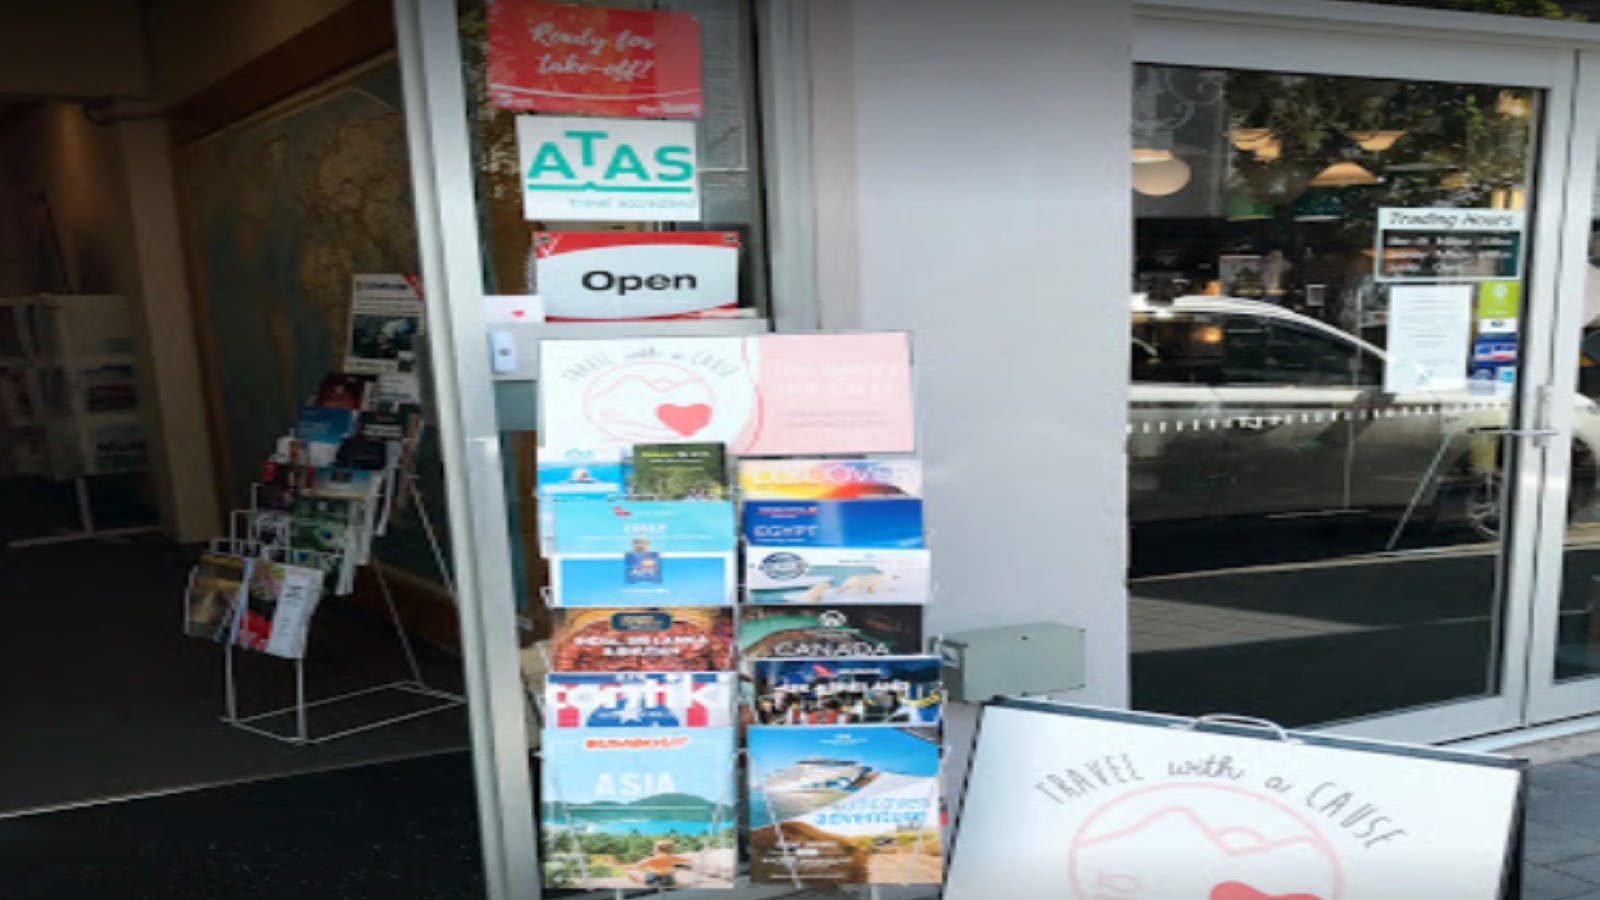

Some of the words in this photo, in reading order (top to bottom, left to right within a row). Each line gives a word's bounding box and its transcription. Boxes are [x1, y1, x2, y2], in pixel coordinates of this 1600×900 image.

[531, 21, 606, 55] Ready
[613, 28, 654, 51] for
[527, 131, 694, 182] ATAS
[1389, 211, 1459, 229] Trading
[581, 270, 697, 296] Open
[753, 524, 818, 537] EGYPT
[774, 640, 890, 656] CANADA
[595, 772, 677, 797] ASIA
[1034, 753, 1145, 805] TRAVEL
[1167, 755, 1247, 781] with
[1264, 774, 1293, 794] a
[1304, 780, 1408, 850] CAUSE
